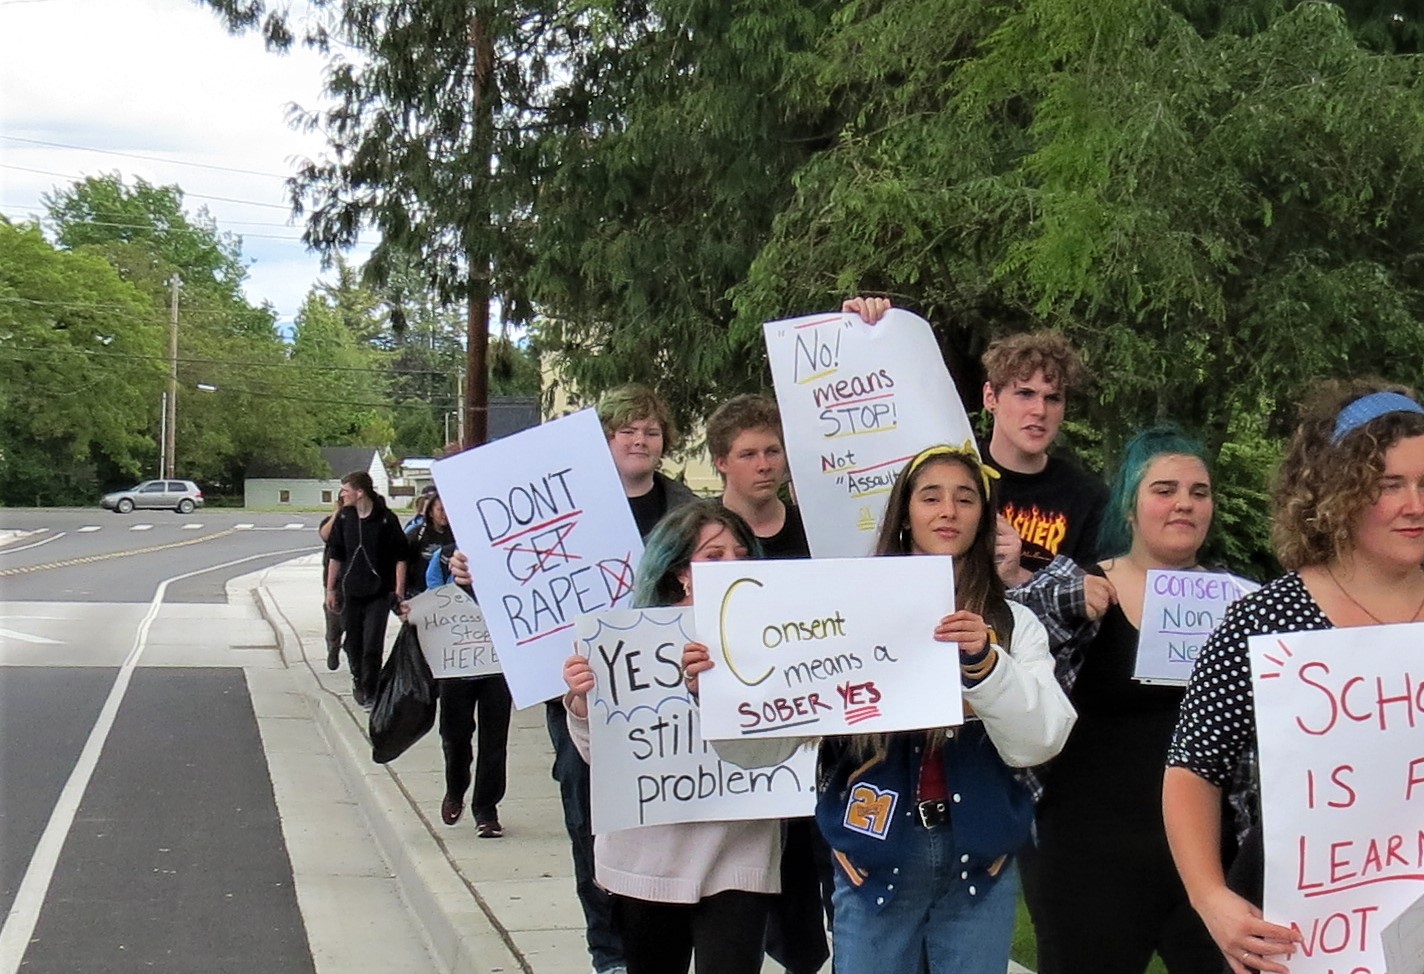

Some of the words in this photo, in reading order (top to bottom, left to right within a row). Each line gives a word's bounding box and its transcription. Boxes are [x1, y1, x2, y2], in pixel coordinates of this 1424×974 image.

[813, 369, 895, 408] means
[819, 402, 898, 438] STOP!
[821, 449, 857, 472] Not
[506, 522, 574, 582] GET
[443, 646, 500, 671] HERE
[598, 639, 684, 706] YES
[783, 653, 863, 688] means
[873, 645, 898, 662] a
[738, 692, 833, 728] SOBER
[836, 678, 882, 710] YES
[628, 709, 708, 760] stil
[637, 759, 816, 825] problem.
[847, 786, 894, 835] 21
[1307, 763, 1357, 809] IS
[1286, 906, 1379, 961] NOT
